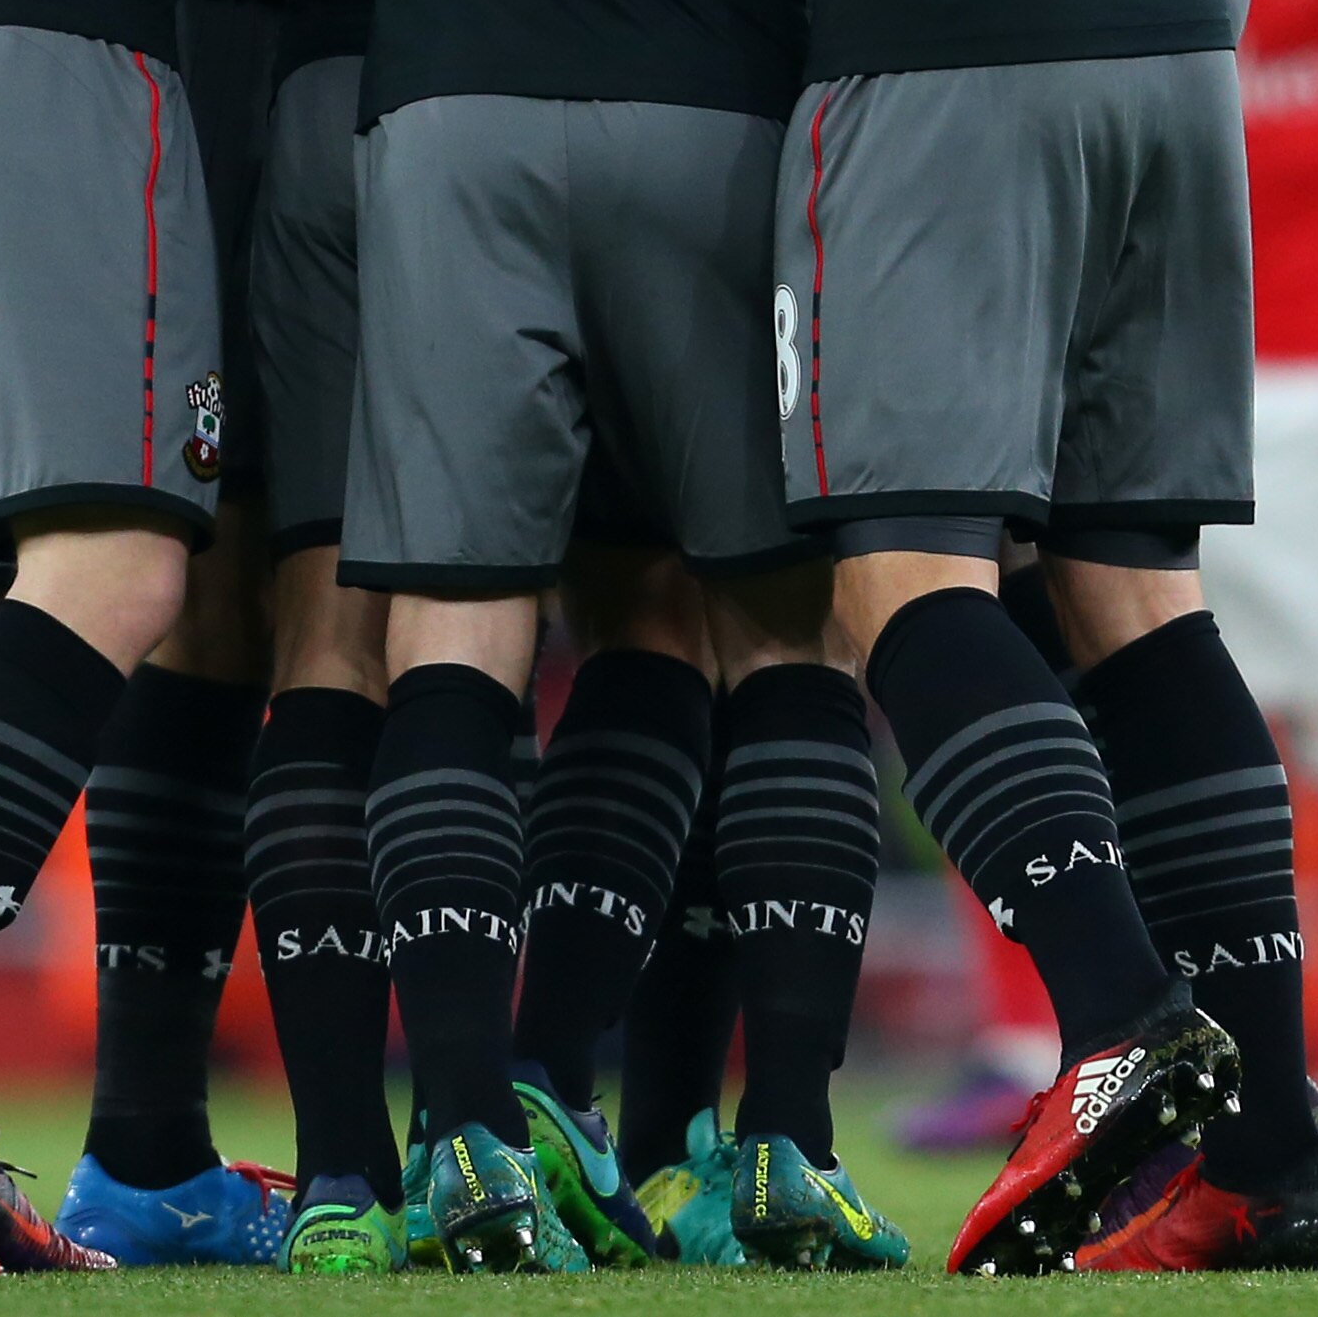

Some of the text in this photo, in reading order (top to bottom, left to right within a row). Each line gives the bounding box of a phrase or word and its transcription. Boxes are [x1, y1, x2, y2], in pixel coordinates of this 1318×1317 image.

[774, 283, 801, 421] 8
[1025, 839, 1125, 888] SAI
[277, 924, 385, 964] SAI
[727, 899, 865, 946] AINTS
[1173, 930, 1305, 978] SAIN
[1075, 1047, 1147, 1135] adidas
